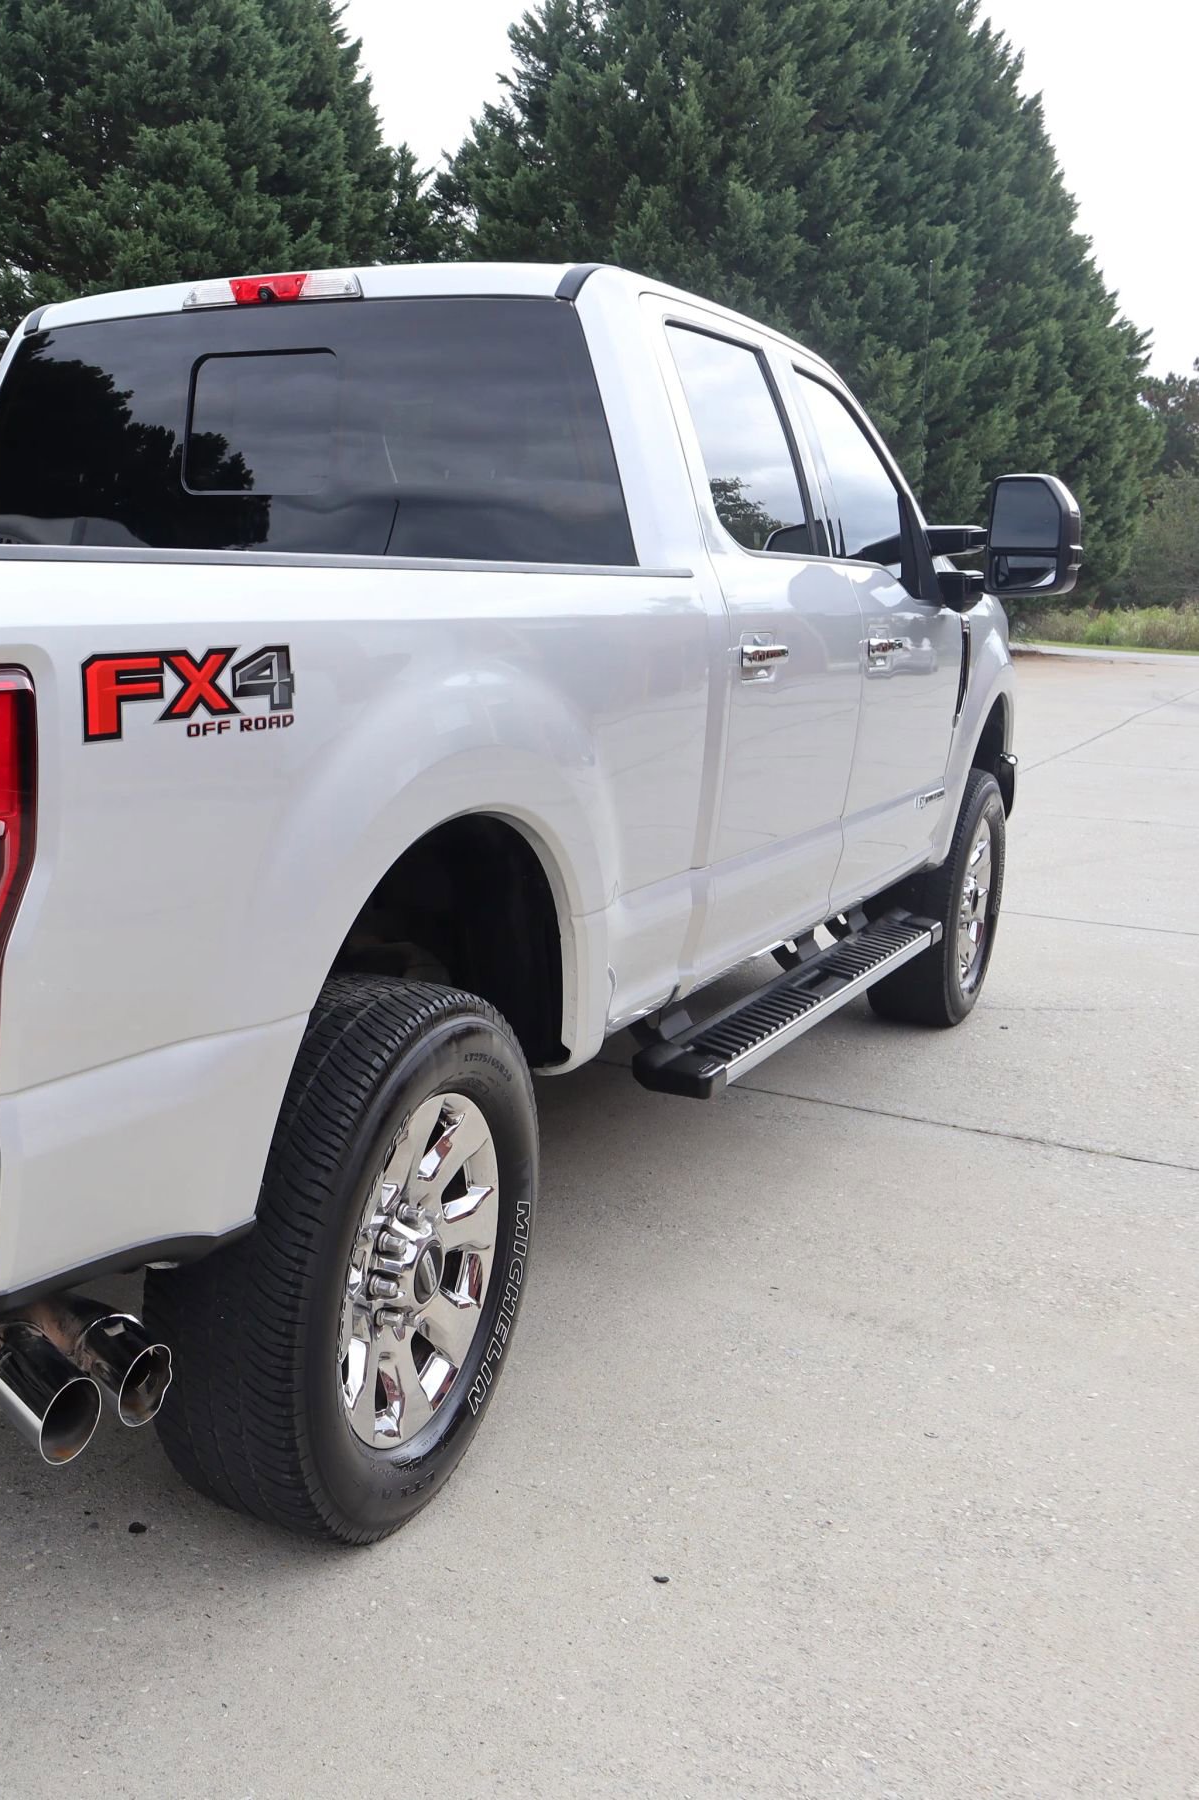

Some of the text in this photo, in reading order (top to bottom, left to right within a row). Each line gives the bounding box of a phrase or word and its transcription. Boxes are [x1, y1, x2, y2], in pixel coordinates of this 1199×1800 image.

[81, 644, 295, 743] FX4
[186, 714, 295, 738] OFF ROAD
[467, 1200, 531, 1416] MICHELIN
